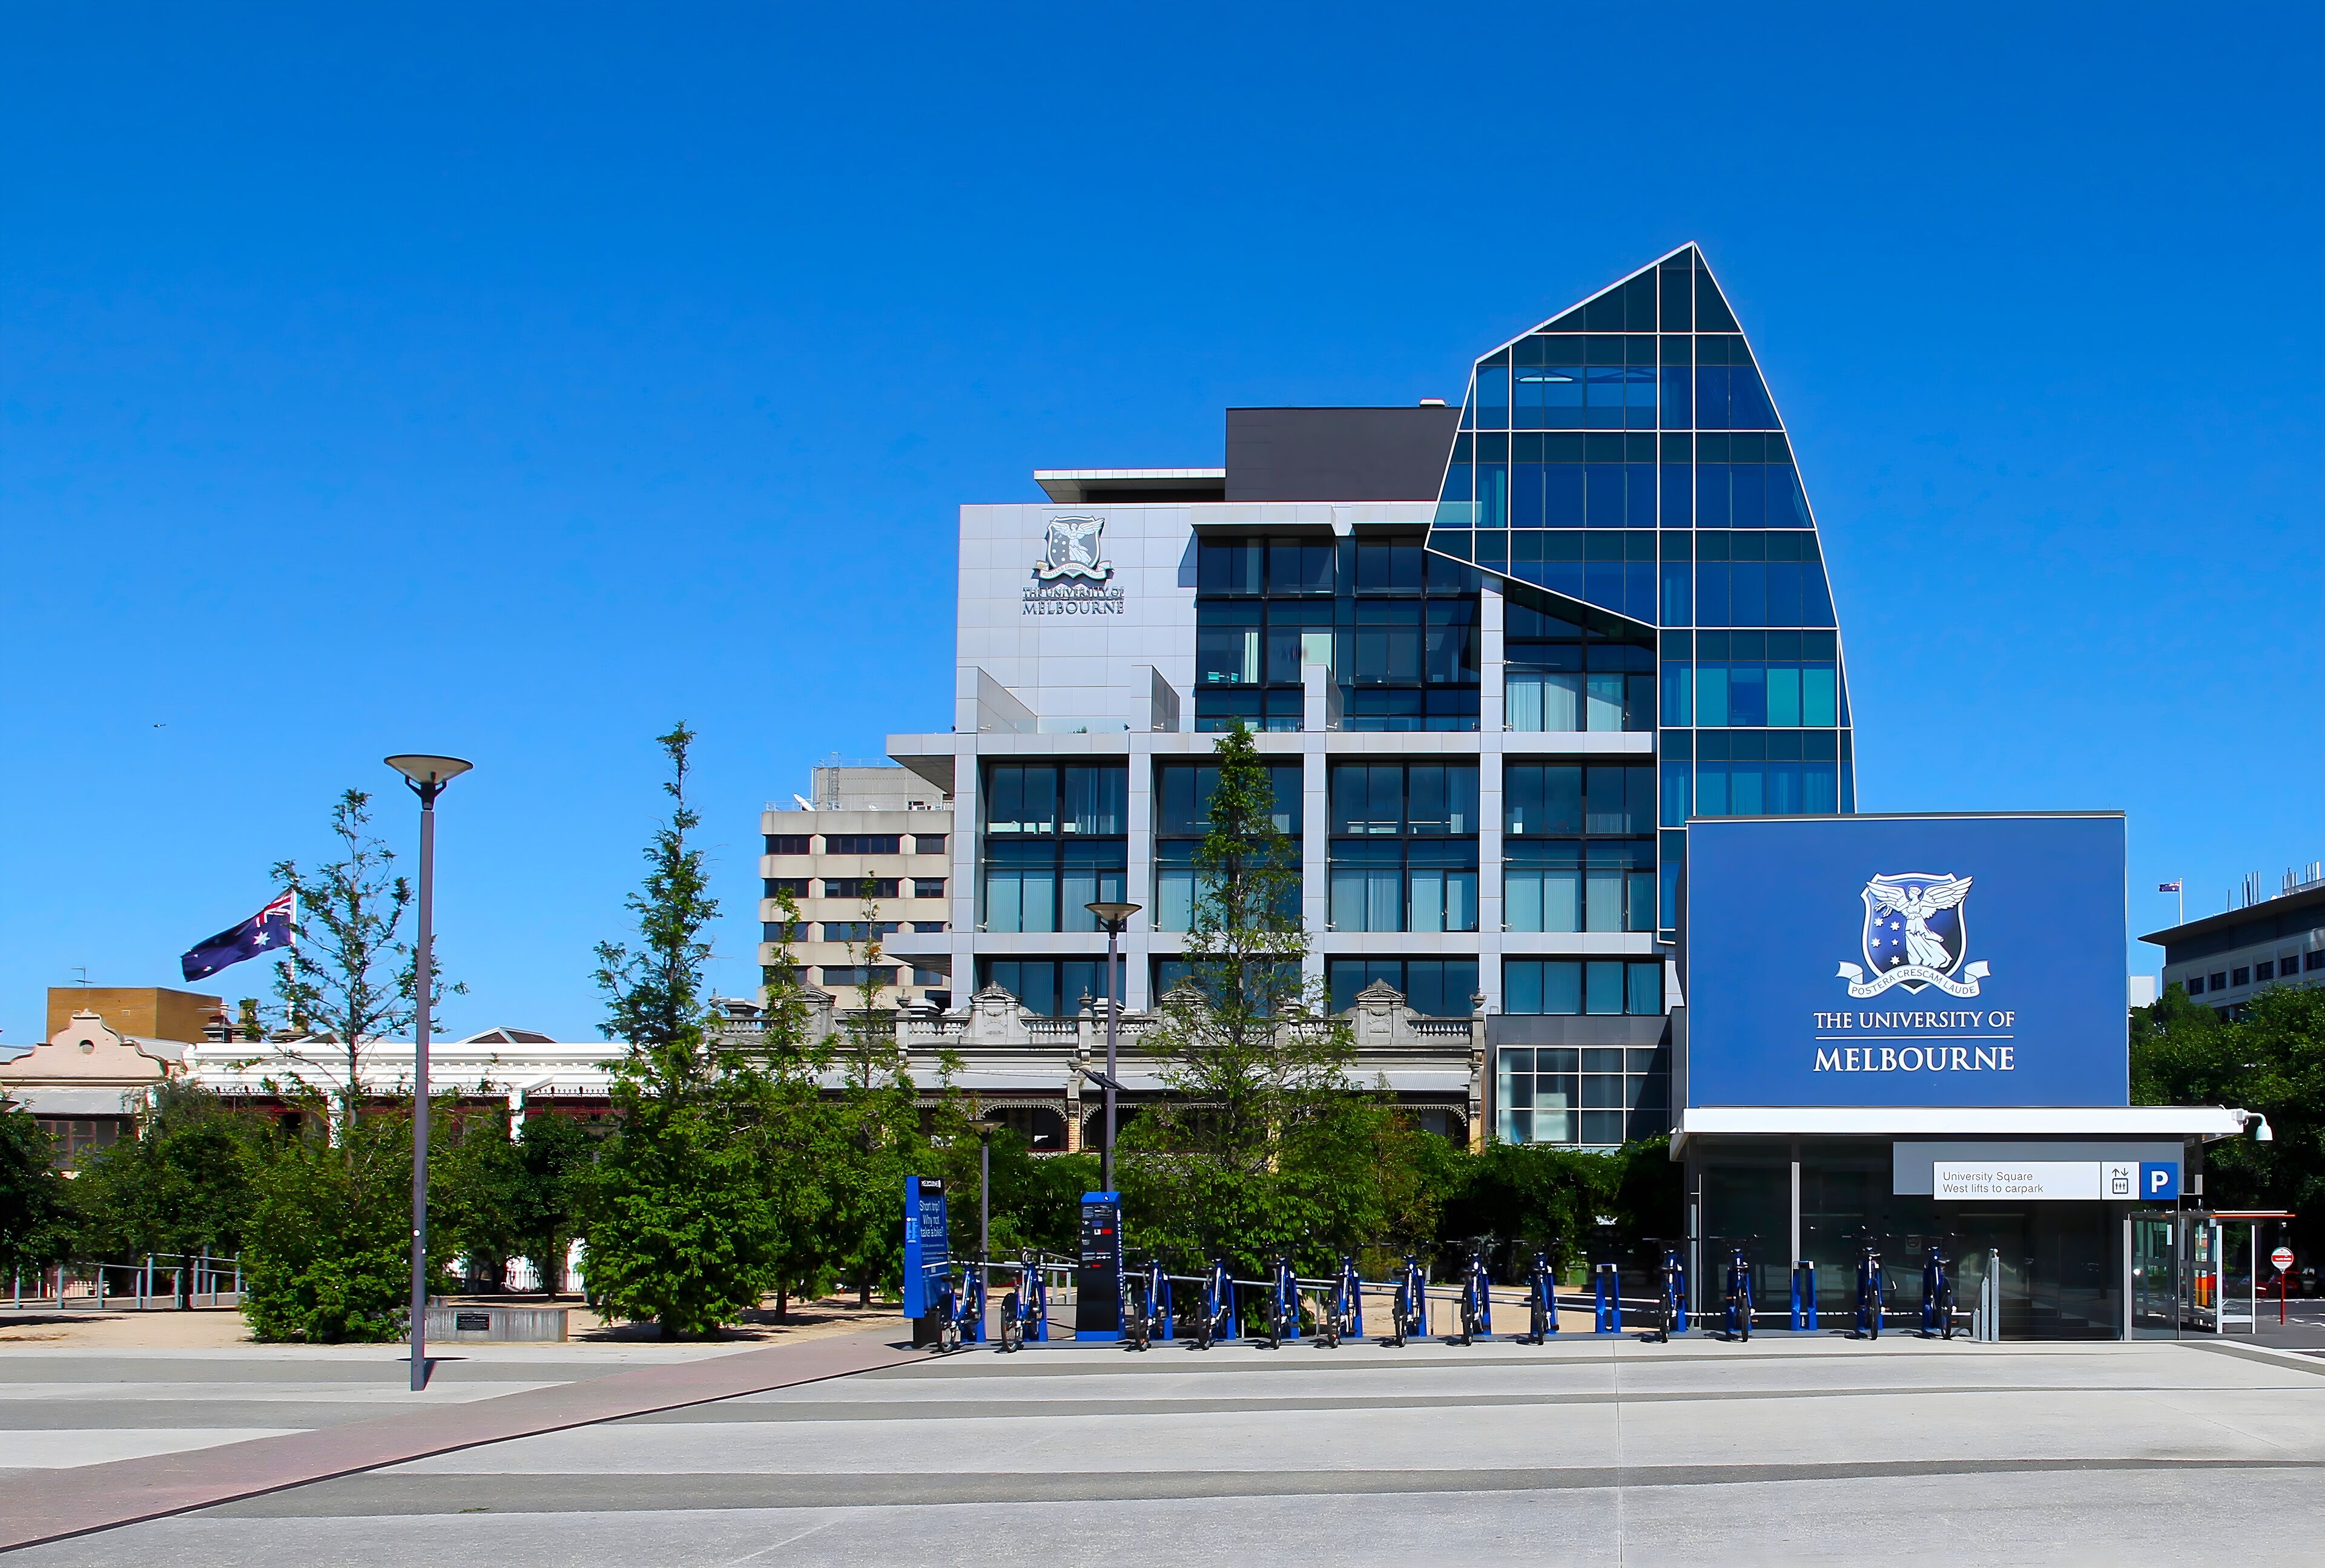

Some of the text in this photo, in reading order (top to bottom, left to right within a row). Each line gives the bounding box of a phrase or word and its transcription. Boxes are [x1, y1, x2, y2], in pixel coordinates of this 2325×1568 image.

[1023, 587, 1125, 597] THE UNIVERSITY OF
[1022, 599, 1125, 615] MELBOURNE
[1852, 969, 1976, 995] POSTERA CRESCAM LAUDE
[1813, 1010, 2016, 1029] THE UNIVERSITY OF
[1813, 1046, 2016, 1072] MELBOURNE
[1942, 1171, 2033, 1183] University Square
[2151, 1170, 2169, 1193] P
[1942, 1184, 2044, 1194] West lifts to carpark
[922, 1214, 932, 1227] Why
[920, 1227, 931, 1237] take
